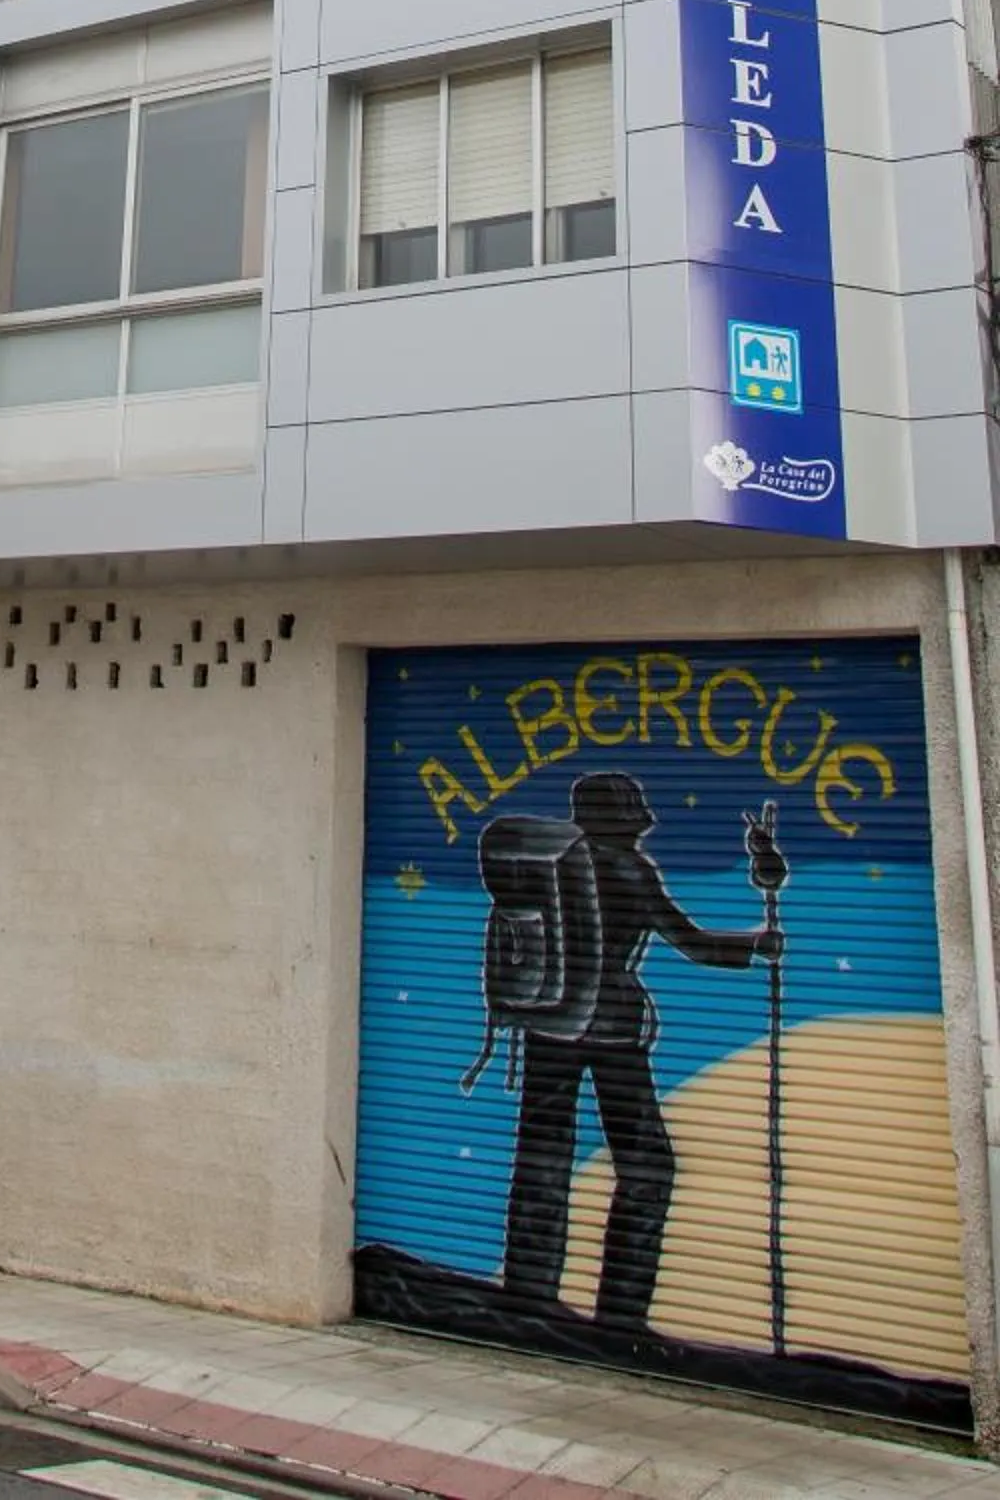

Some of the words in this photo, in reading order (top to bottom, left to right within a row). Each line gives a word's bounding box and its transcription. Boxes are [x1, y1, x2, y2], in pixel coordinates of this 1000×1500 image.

[760, 461, 776, 475] La
[777, 463, 806, 479] Casa
[807, 466, 826, 482] del
[416, 652, 898, 846] ALBERGUE
